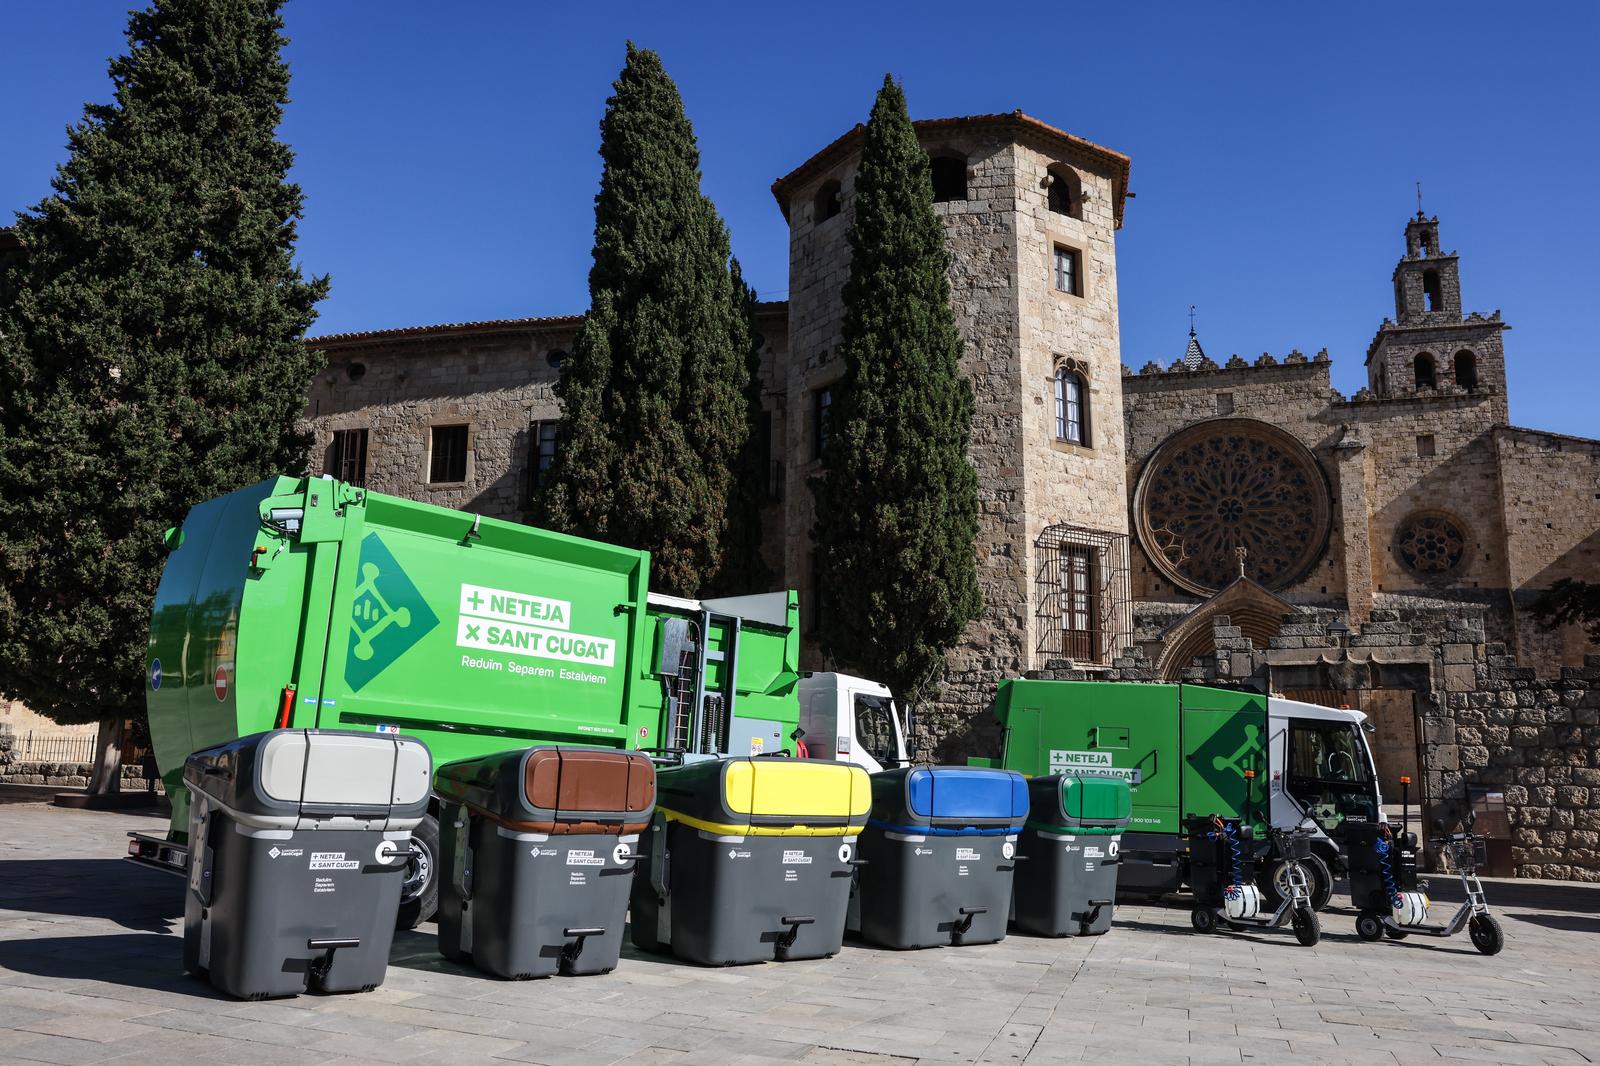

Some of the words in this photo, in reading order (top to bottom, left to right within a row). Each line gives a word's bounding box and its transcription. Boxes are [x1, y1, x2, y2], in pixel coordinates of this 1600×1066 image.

[489, 594, 565, 624] NETEJA
[486, 626, 543, 651] SANT
[545, 635, 609, 660] CUGAT
[461, 655, 503, 671] Reduïm
[507, 661, 554, 677] Separem
[559, 668, 607, 684] Estalviem
[1065, 753, 1109, 764] NETEJA
